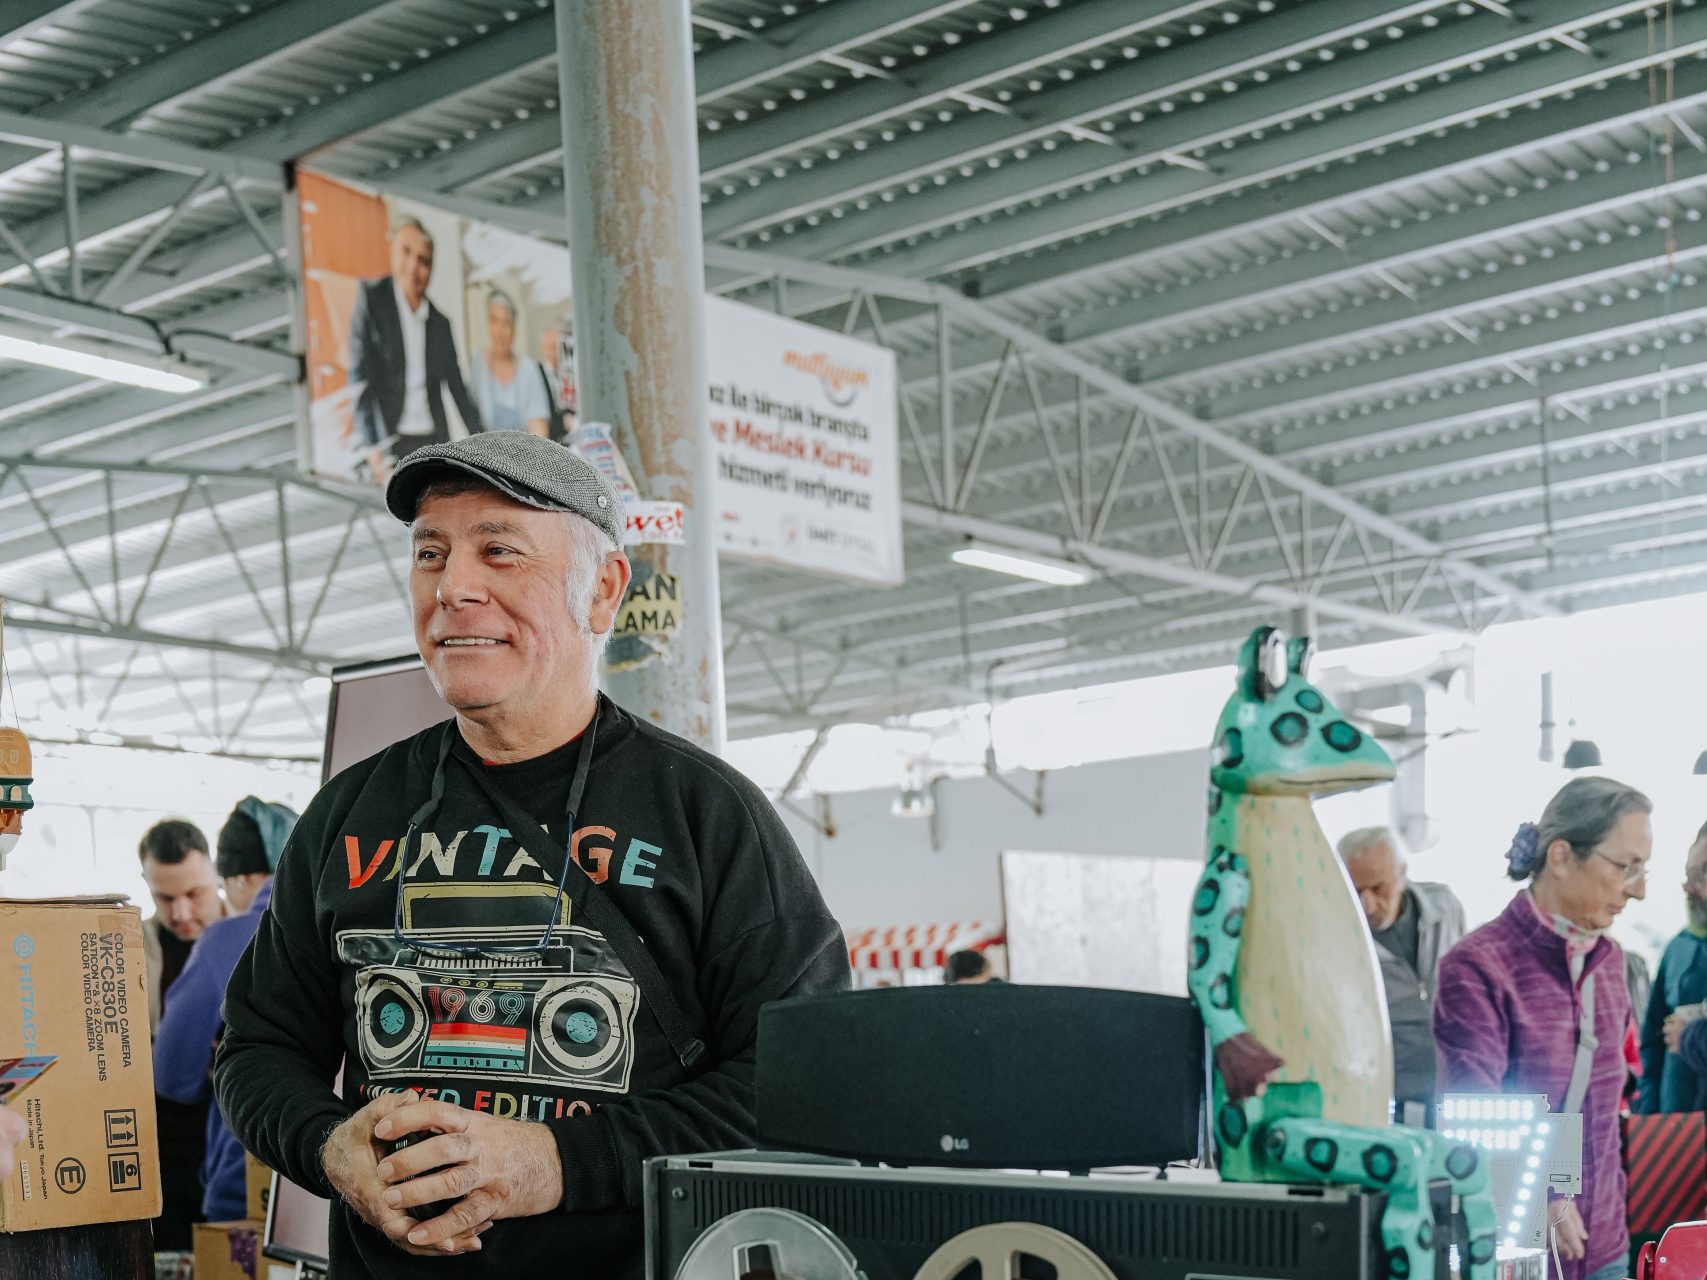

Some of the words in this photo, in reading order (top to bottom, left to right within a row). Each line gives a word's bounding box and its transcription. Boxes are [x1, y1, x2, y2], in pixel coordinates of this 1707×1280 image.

[732, 419, 805, 458] Meslek
[812, 439, 872, 477] Kursu
[344, 824, 663, 890] VINTAGE
[80, 933, 89, 970] COLOR
[114, 933, 125, 975] COLOR
[83, 973, 92, 1005] VIDEO
[117, 979, 128, 1015] VIDEO
[427, 986, 526, 1025] 1969
[17, 964, 39, 1058] HITACH
[86, 1008, 96, 1052] CAMERA
[94, 1018, 105, 1051] ZOOM
[119, 1018, 131, 1068] CAMERA
[97, 1053, 107, 1082] LENS
[473, 1089, 601, 1122] EDITIO
[28, 1127, 36, 1149] Japan
[60, 1165, 81, 1186] E
[125, 1163, 138, 1177] 6
